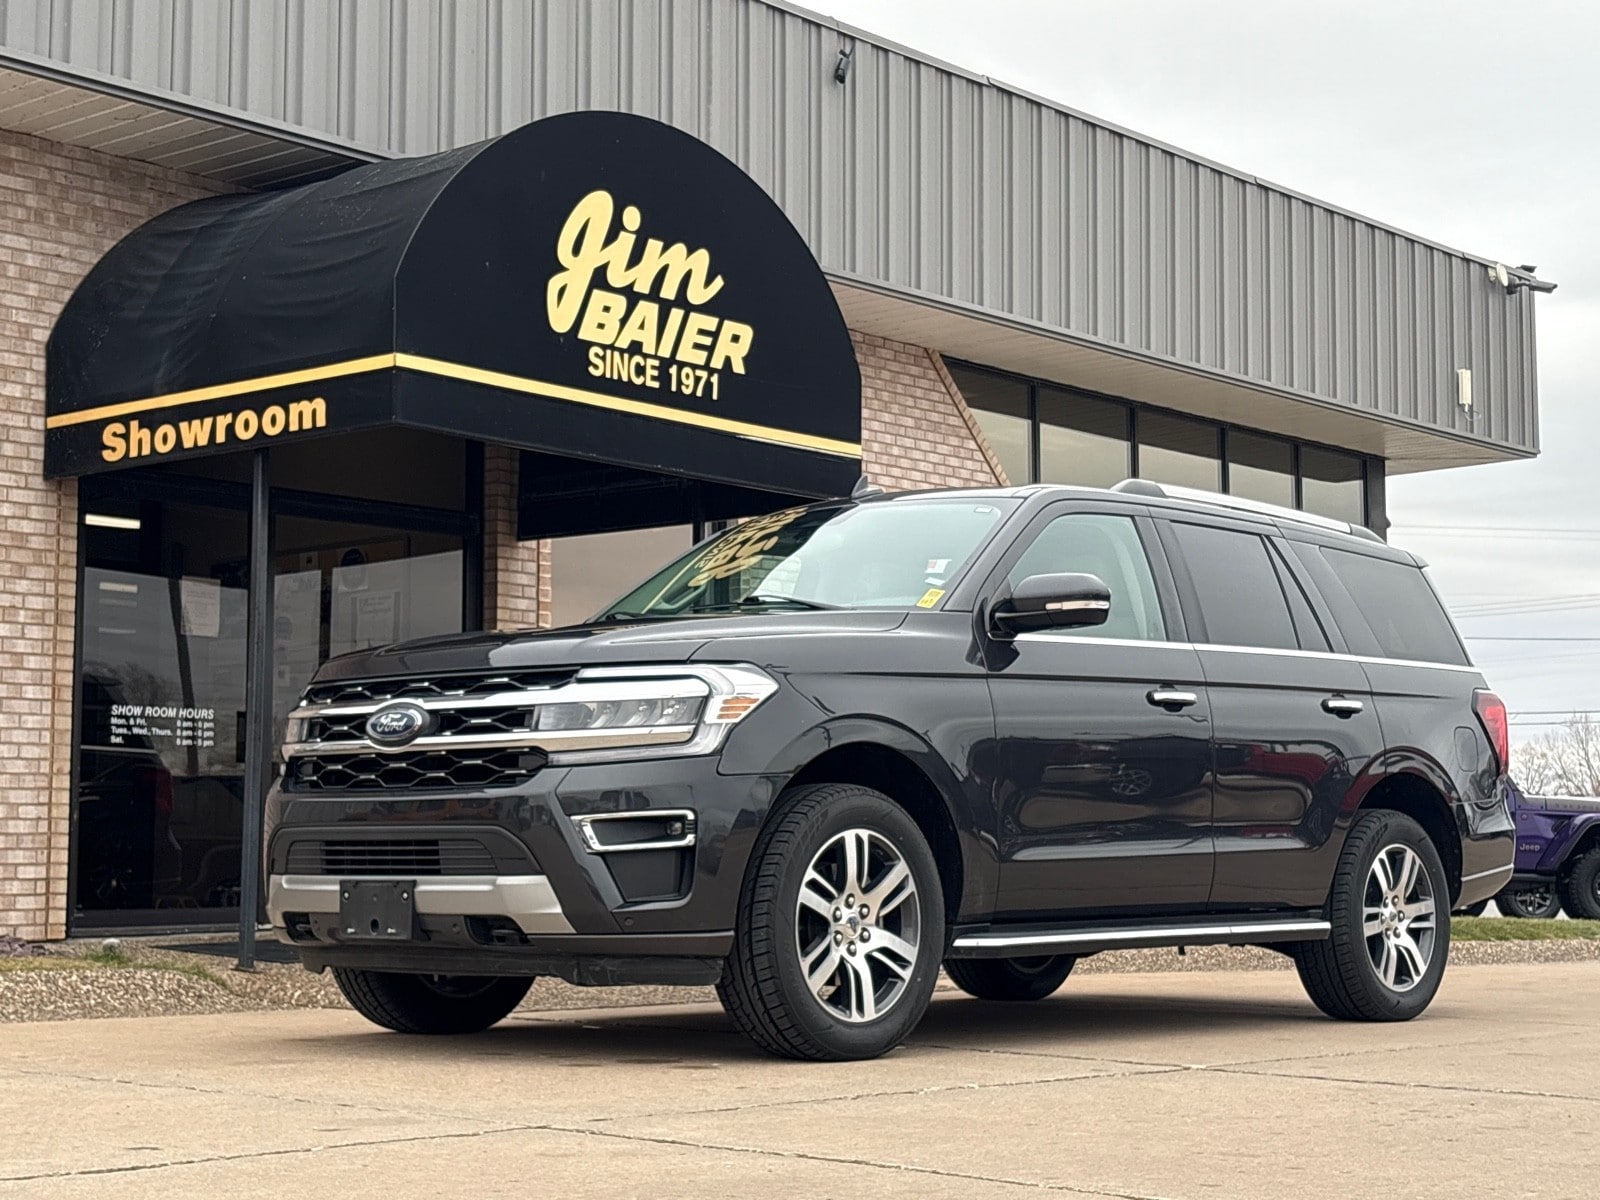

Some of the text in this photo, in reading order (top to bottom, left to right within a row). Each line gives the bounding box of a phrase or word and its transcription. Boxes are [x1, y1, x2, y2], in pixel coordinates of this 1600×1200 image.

[547, 190, 725, 333] Jim
[577, 289, 754, 375] BAIER
[588, 346, 719, 400] SINCE 1971
[102, 397, 327, 462] Showroom
[111, 704, 215, 719] SHOW ROOM HOURS
[203, 721, 214, 729] pm
[377, 713, 408, 732] Ford
[203, 730, 214, 738] pm
[203, 740, 214, 748] pm
[1520, 843, 1540, 852] Jeep
